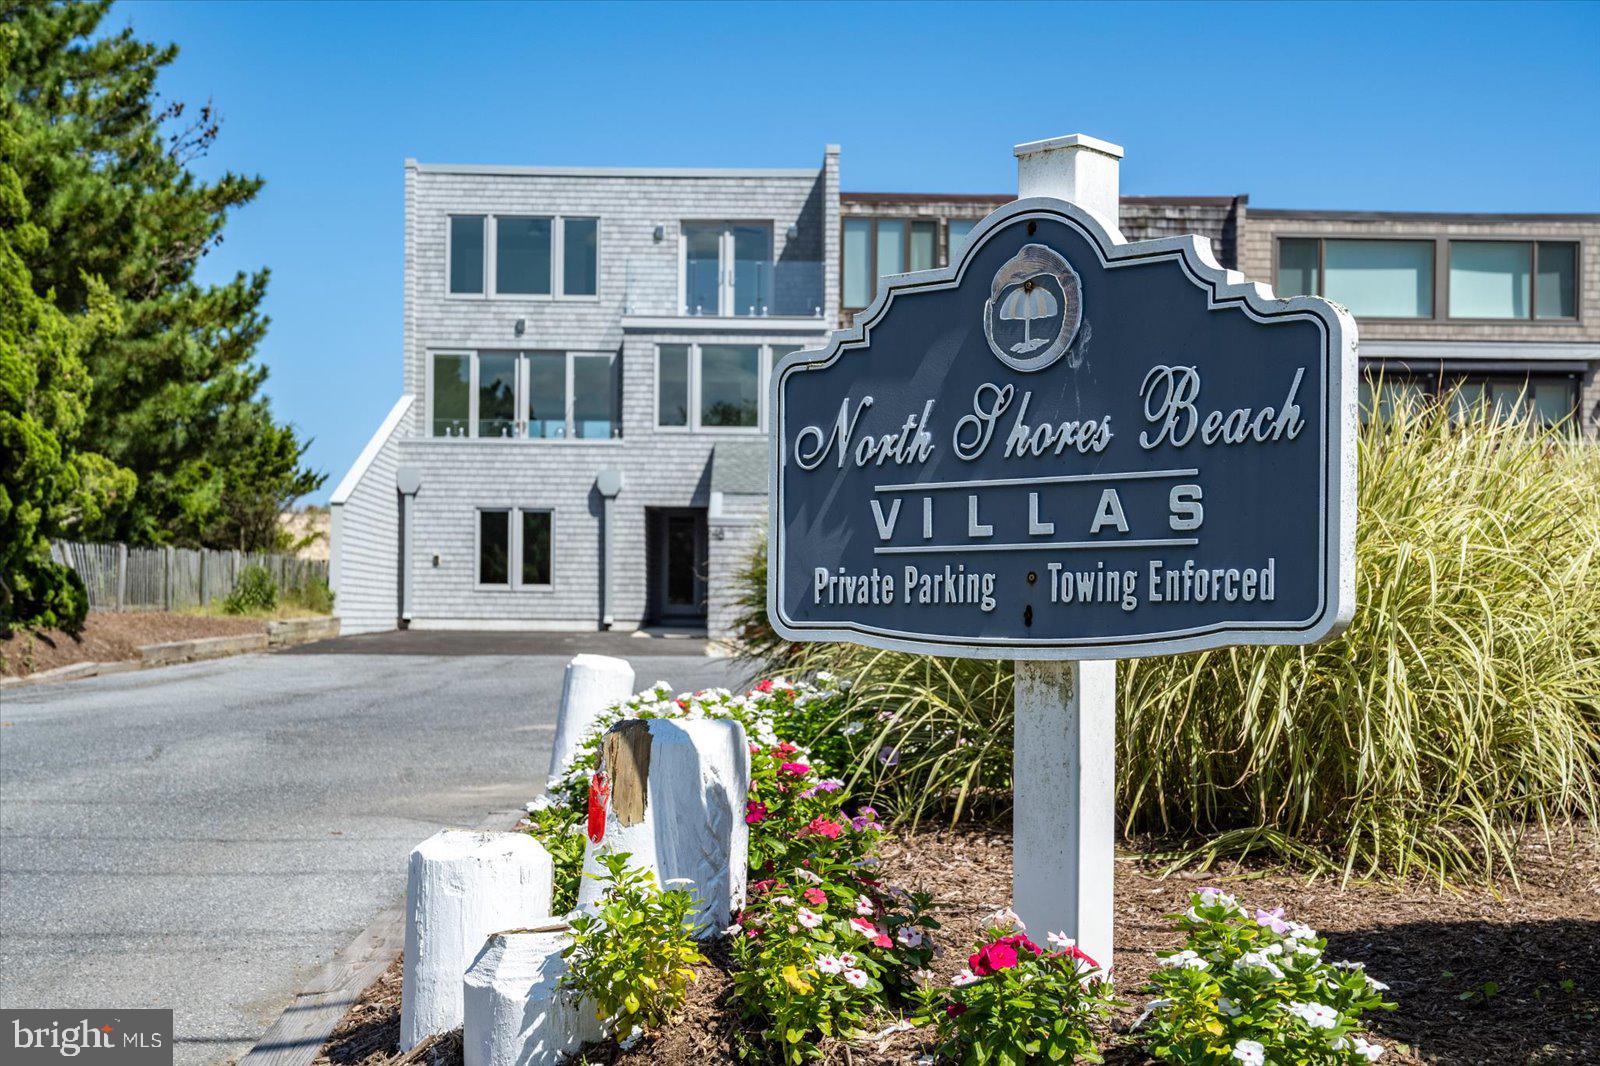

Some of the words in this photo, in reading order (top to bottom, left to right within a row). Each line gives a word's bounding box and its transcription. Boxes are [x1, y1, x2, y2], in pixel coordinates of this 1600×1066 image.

[794, 396, 934, 469] North
[953, 382, 1113, 461] Shores
[1139, 365, 1305, 450] Beach
[870, 484, 1203, 540] VILLAS
[814, 567, 895, 605] Private
[904, 565, 997, 612] Parking
[1047, 561, 1137, 611] Towing
[1149, 557, 1276, 602] Enforced
